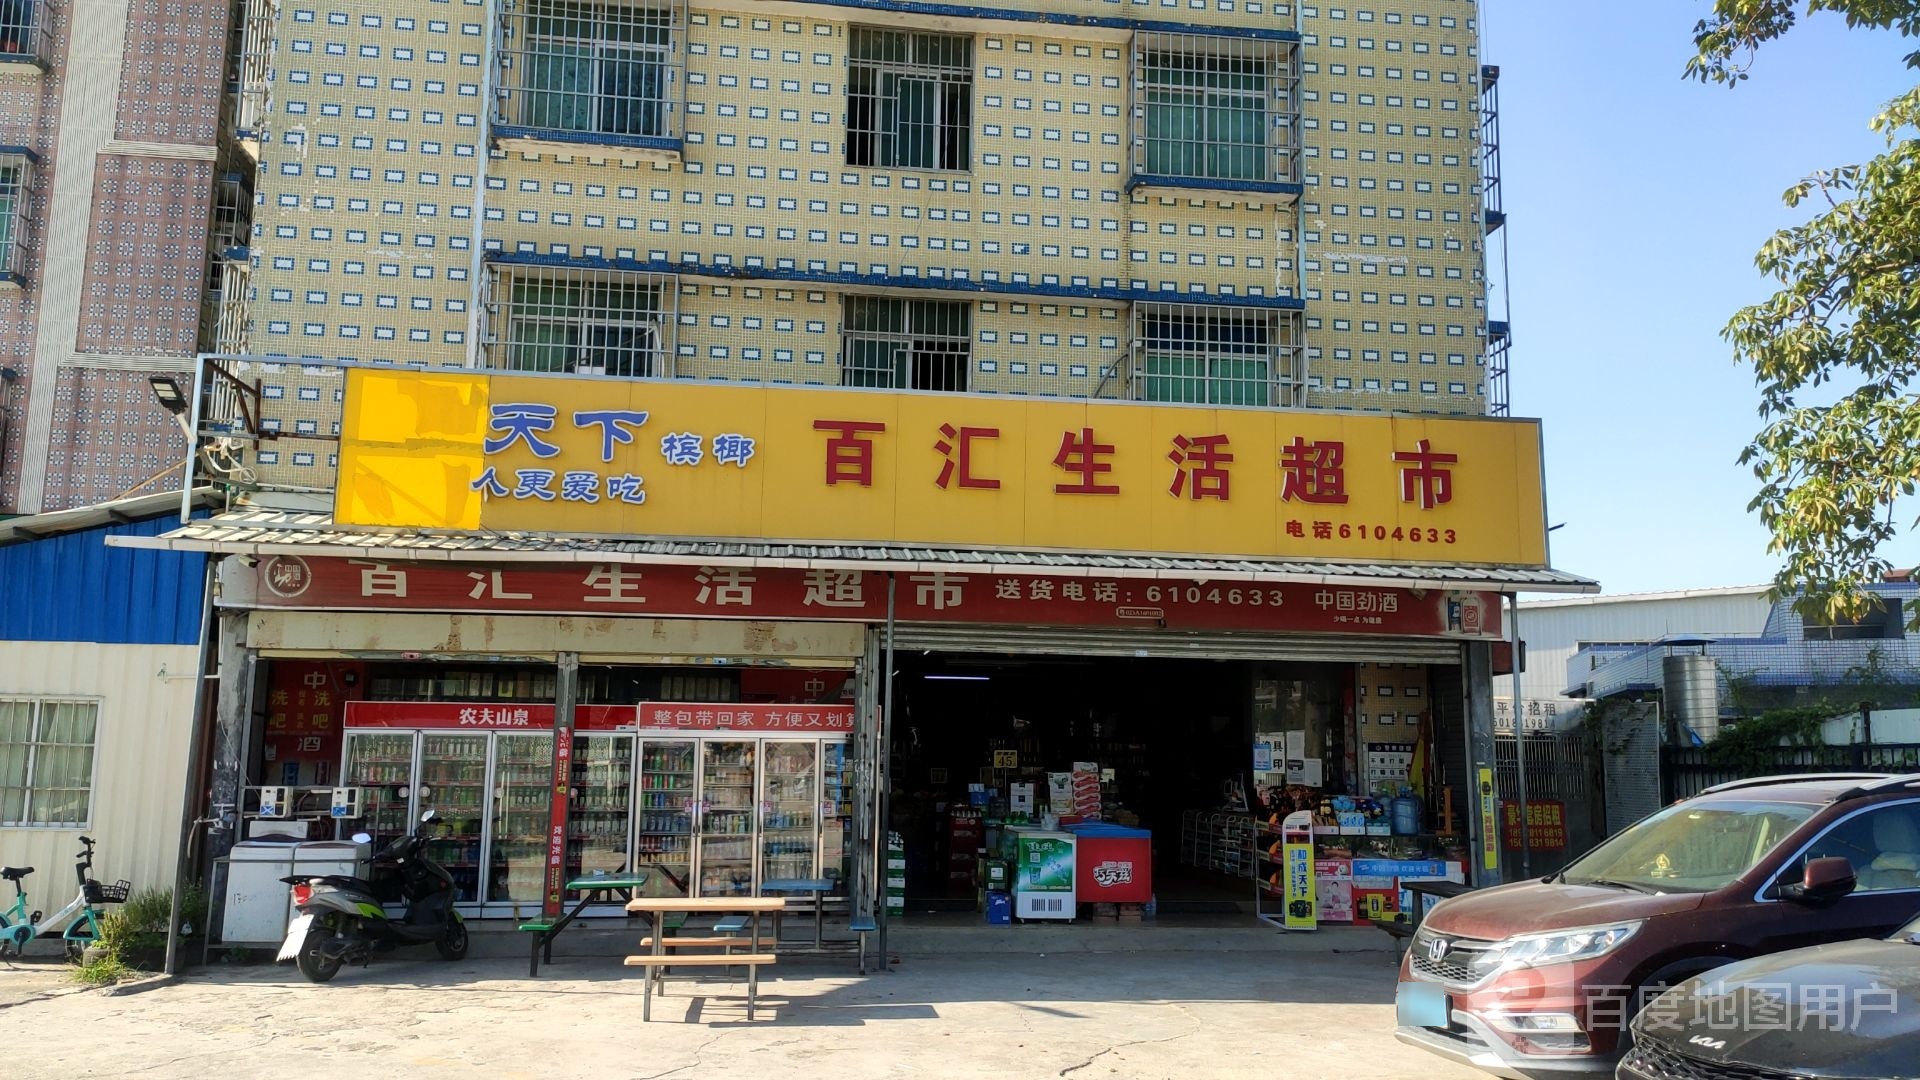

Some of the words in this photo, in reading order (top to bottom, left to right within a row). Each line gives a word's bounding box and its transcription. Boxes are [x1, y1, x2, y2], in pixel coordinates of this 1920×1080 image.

[483, 403, 649, 462] 天下
[661, 432, 755, 467] 槟榔
[812, 419, 1460, 511] 百汇生活超市
[471, 467, 646, 505] 人更爱吃
[1286, 518, 1458, 545] 电话6104633
[348, 558, 969, 610] 百汇生活超市
[1314, 588, 1399, 613] 中国劲酒
[458, 707, 530, 726] 农夫山泉
[654, 709, 755, 727] 整包带回家
